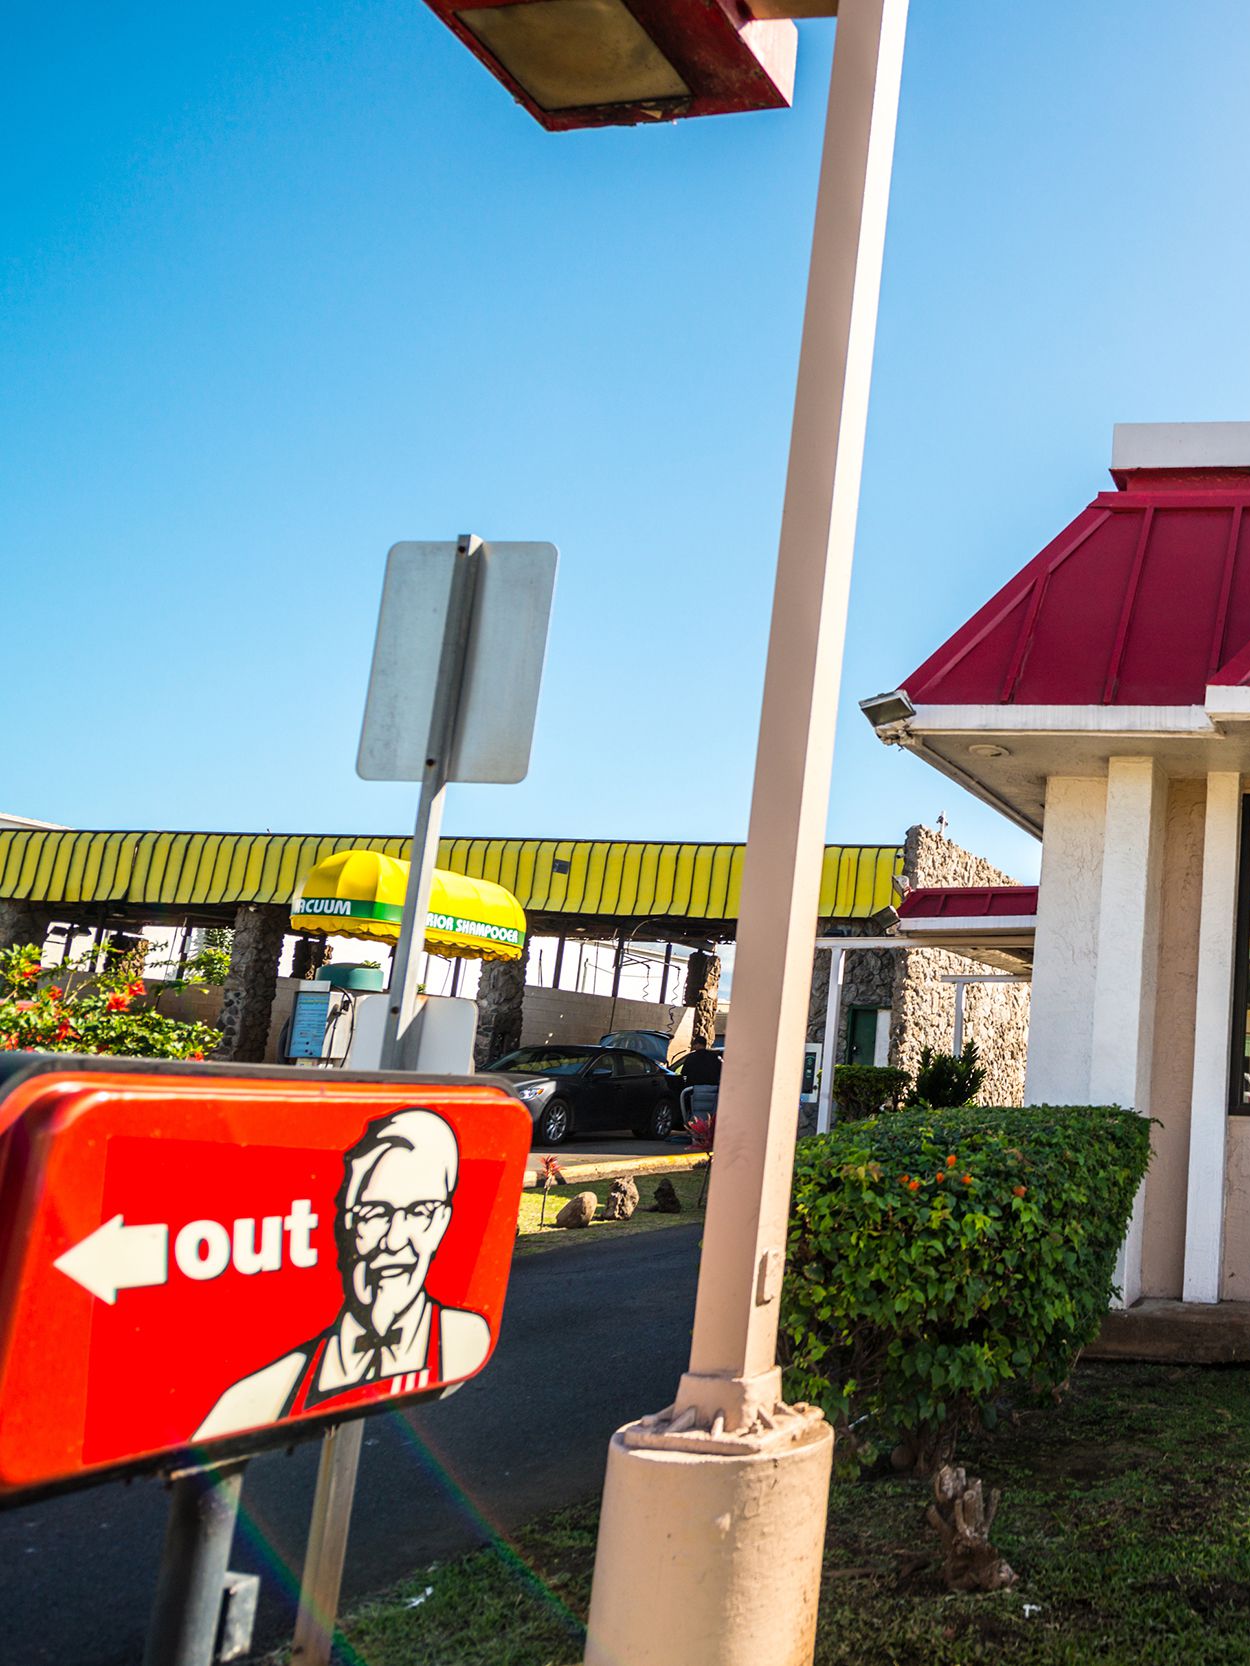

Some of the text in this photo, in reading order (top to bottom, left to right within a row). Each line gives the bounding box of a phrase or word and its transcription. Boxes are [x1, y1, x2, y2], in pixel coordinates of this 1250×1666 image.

[294, 899, 352, 916] ACUUM
[426, 912, 518, 943] RIOR SHAMPOOER
[174, 1198, 319, 1281] out
